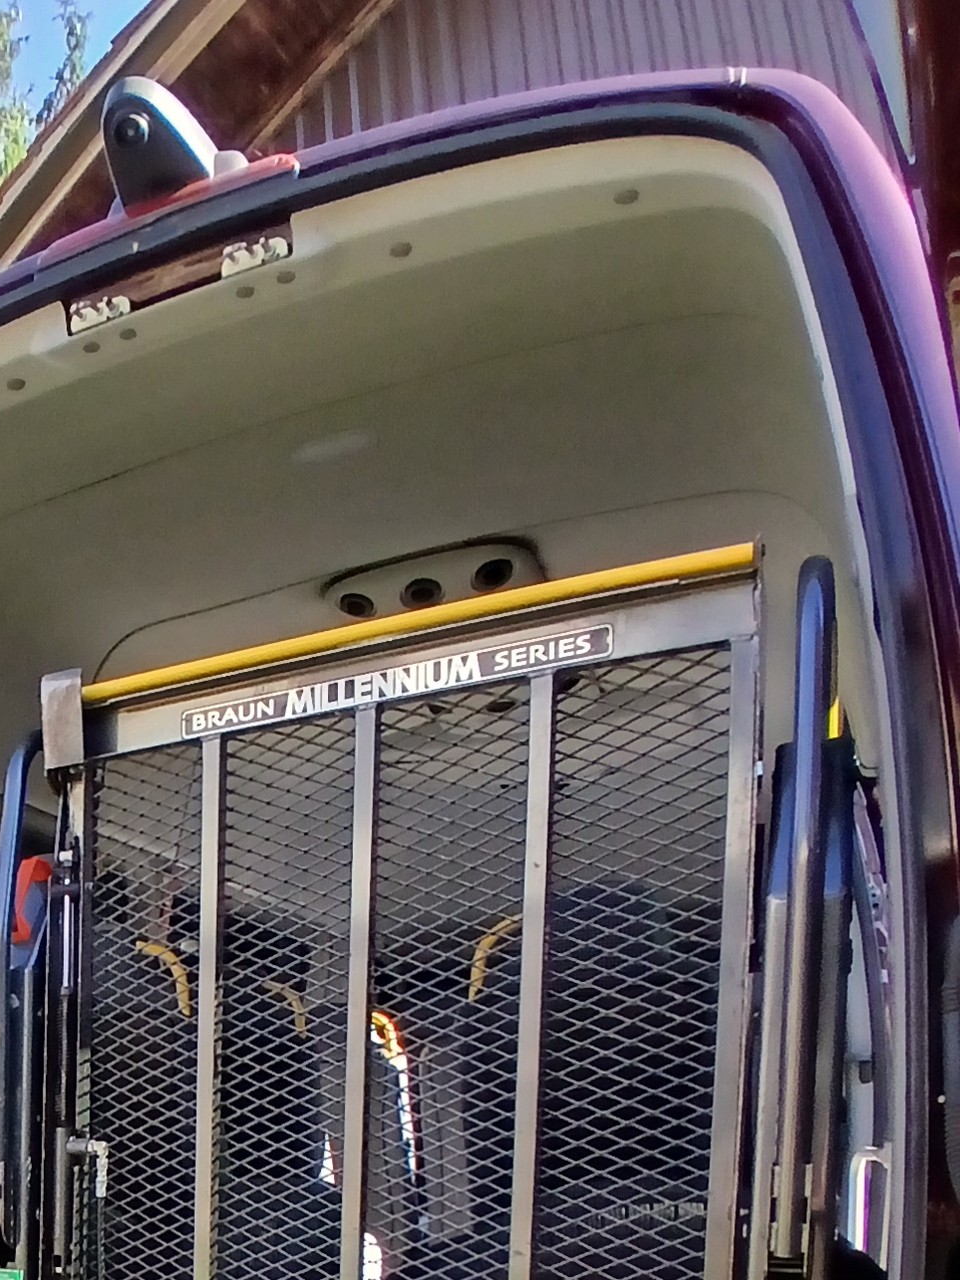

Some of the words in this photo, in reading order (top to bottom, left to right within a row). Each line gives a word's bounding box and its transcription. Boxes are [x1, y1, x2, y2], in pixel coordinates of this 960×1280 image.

[192, 698, 275, 732] BRAUN
[285, 652, 482, 718] MILLENNIUM
[493, 633, 592, 672] SERIES
